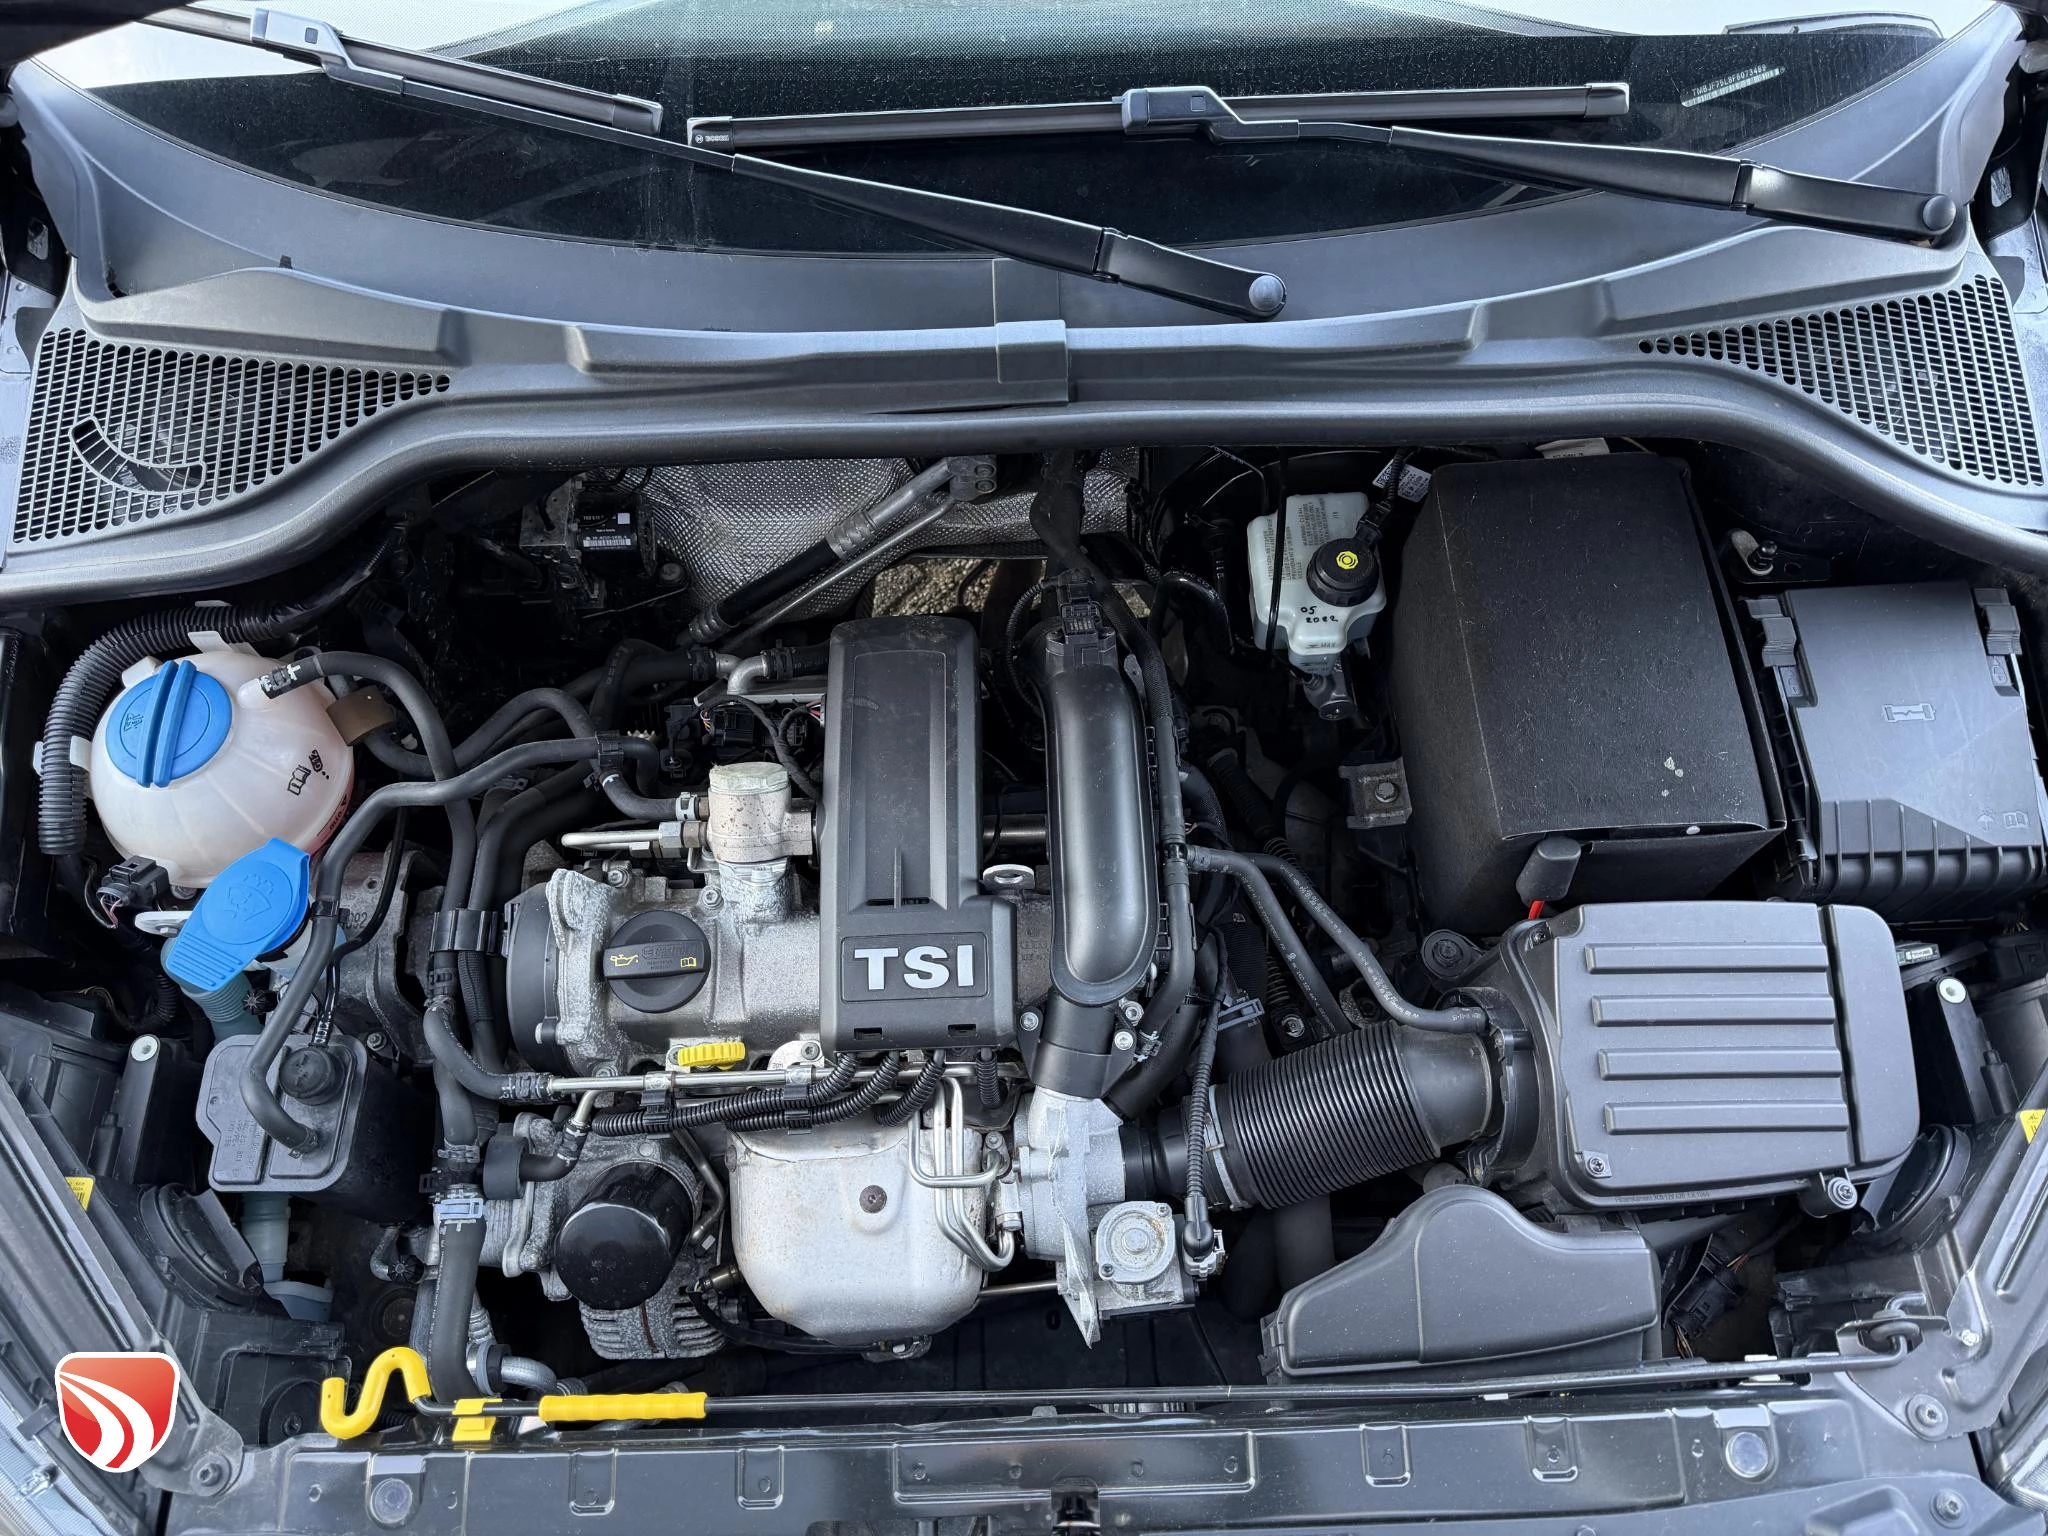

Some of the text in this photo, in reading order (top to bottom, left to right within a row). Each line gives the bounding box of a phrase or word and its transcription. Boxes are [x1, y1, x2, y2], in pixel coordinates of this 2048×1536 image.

[1300, 605, 1318, 615] 05
[1305, 614, 1339, 623] 2022
[854, 944, 974, 990] TSI
